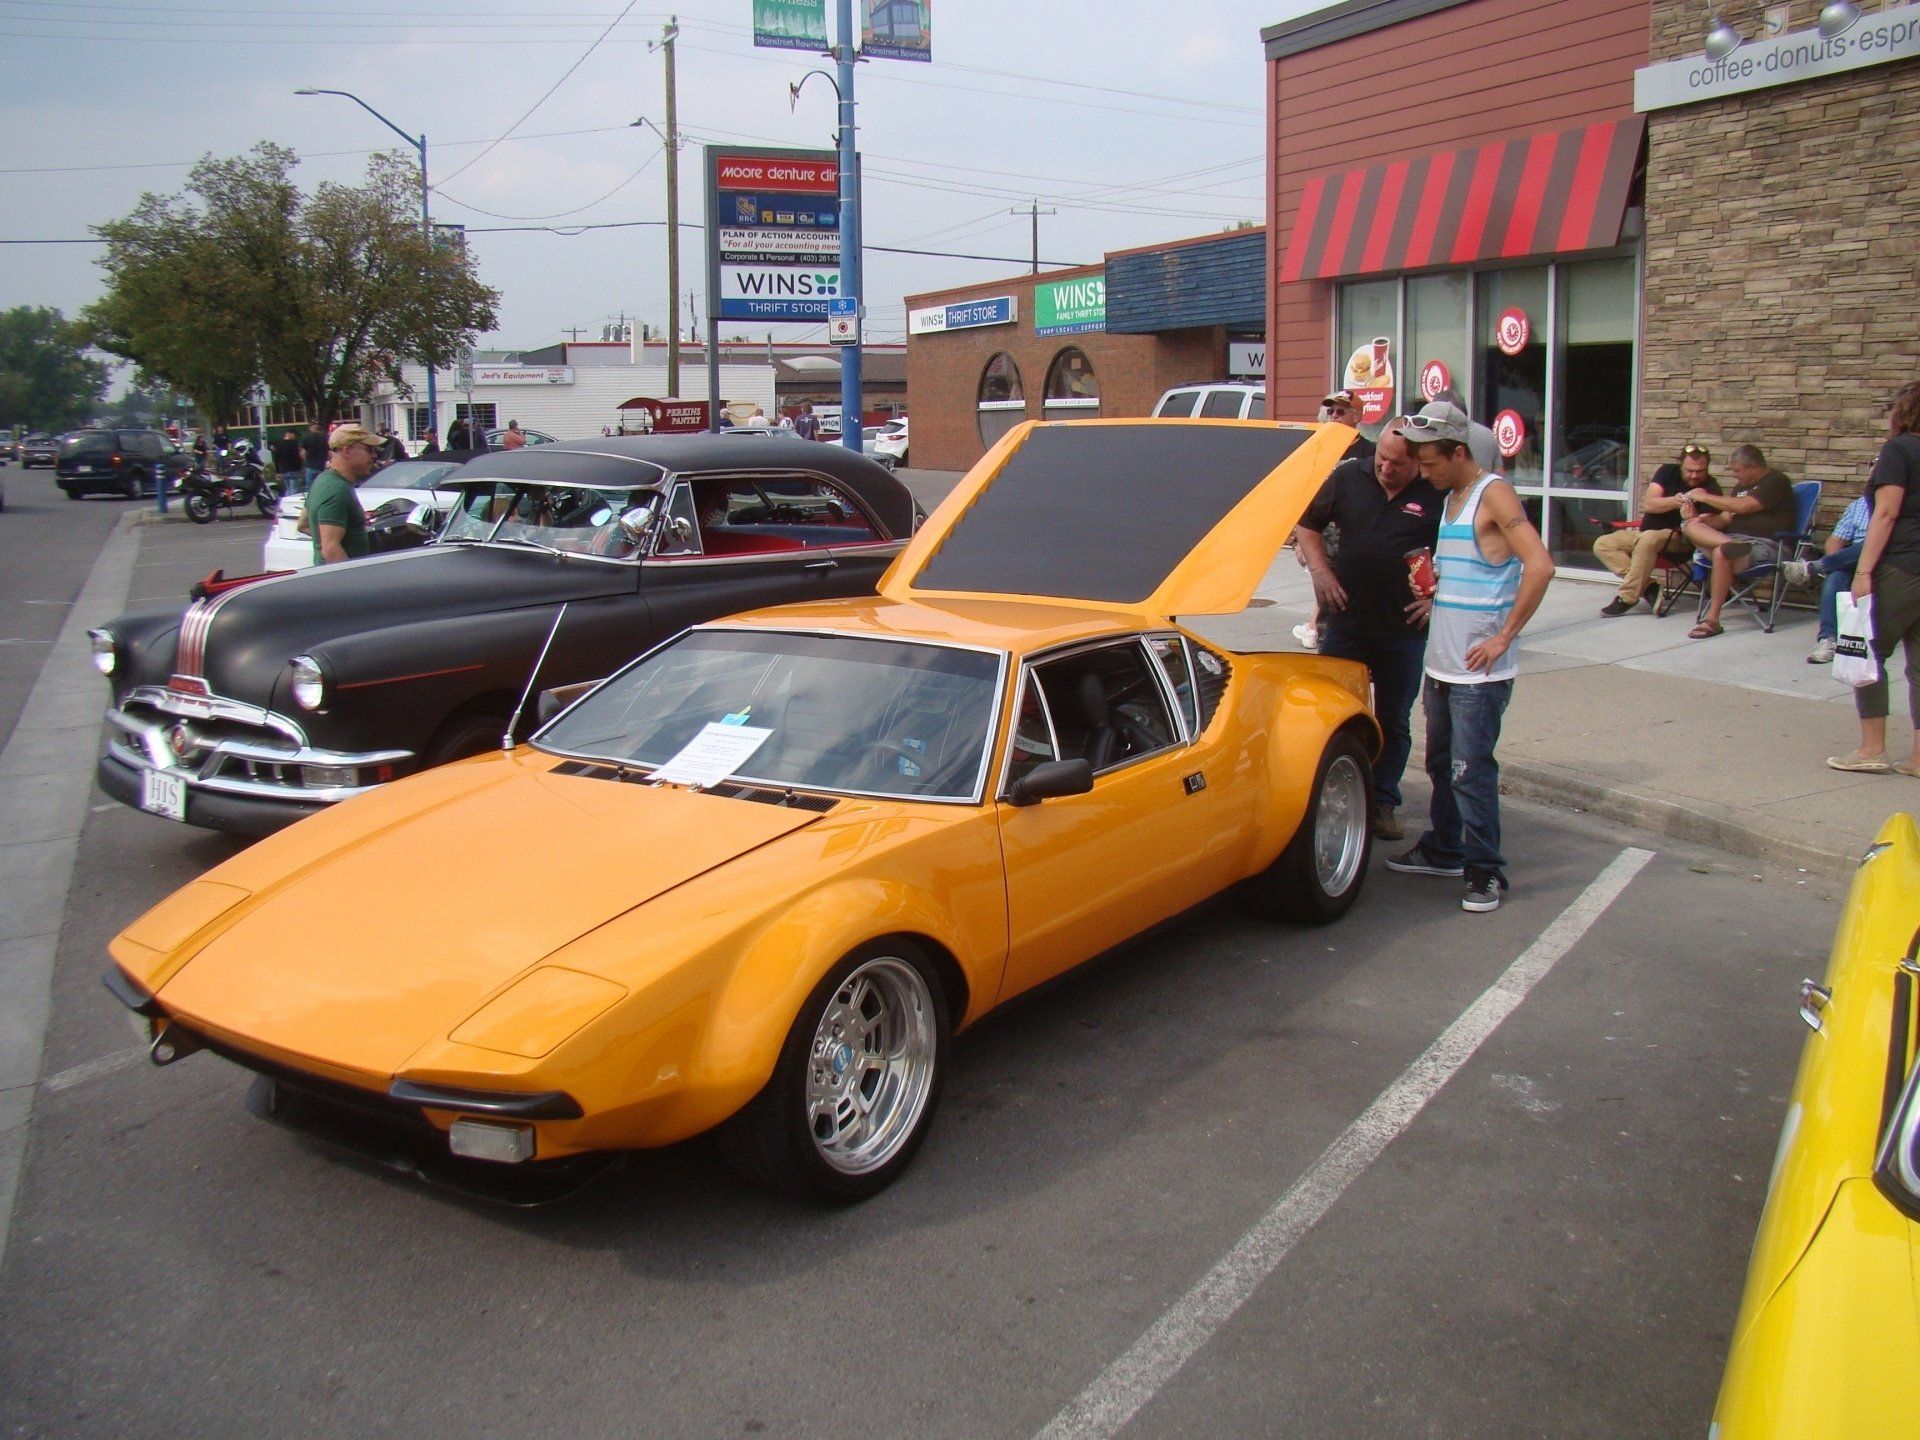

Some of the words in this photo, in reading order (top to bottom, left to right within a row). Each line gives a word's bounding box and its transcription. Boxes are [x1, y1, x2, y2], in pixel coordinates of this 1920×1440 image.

[795, 39, 826, 49] Bowness
[1689, 56, 1753, 88] coffee
[1765, 38, 1846, 72] donuts
[1859, 19, 1920, 52] espr
[767, 167, 816, 181] denture
[775, 242, 820, 251] accounting
[725, 253, 758, 261] Corporate
[800, 254, 817, 263] (403)
[736, 273, 813, 295] WINS
[1053, 282, 1096, 310] WINS
[749, 302, 787, 313] THRIFT
[791, 303, 828, 313] STORE
[920, 314, 938, 328] WINS
[948, 309, 972, 324] THRIFT
[972, 305, 997, 320] STORE
[1056, 311, 1075, 321] FAMILY
[1075, 309, 1092, 319] THRIFT
[1247, 352, 1265, 368] W
[503, 372, 544, 380] Equipment
[666, 408, 701, 417] PERKINS
[671, 416, 701, 425] PANTRY
